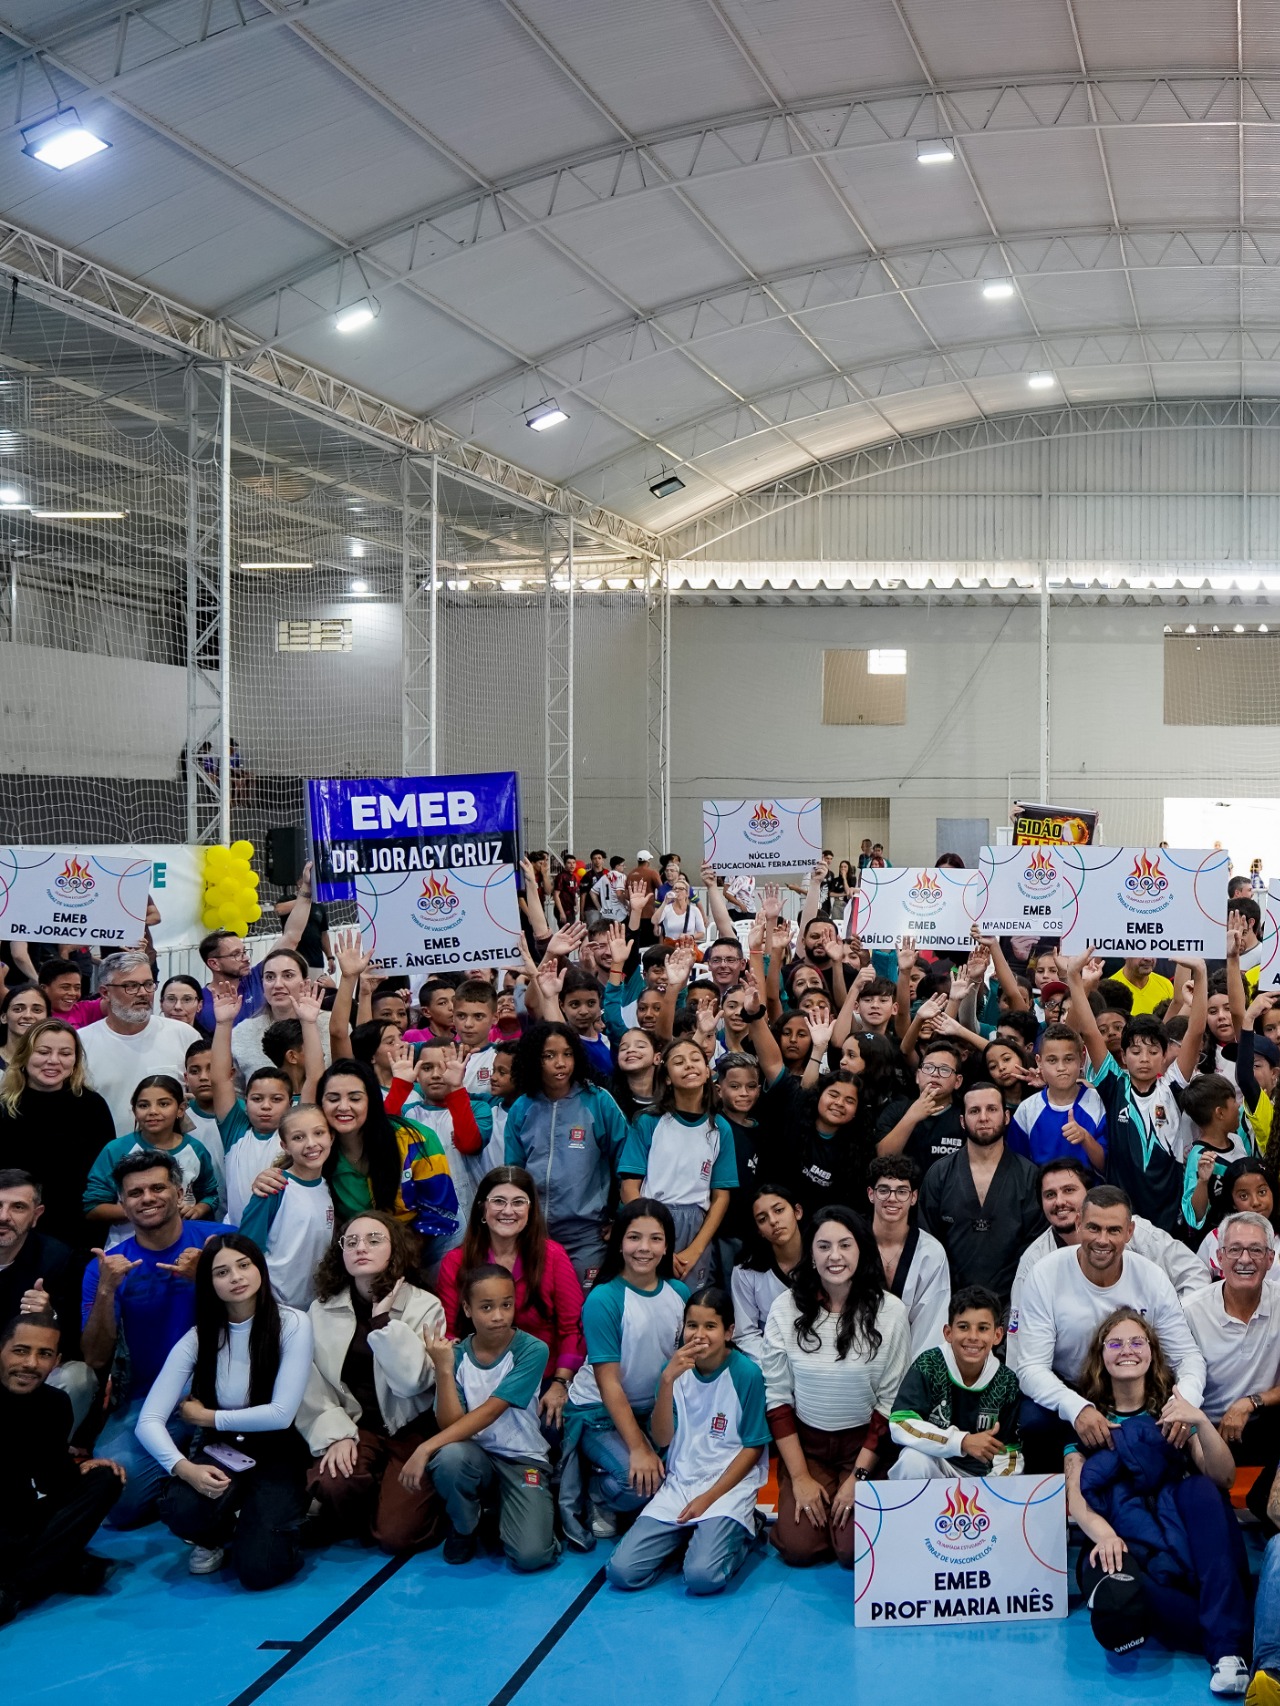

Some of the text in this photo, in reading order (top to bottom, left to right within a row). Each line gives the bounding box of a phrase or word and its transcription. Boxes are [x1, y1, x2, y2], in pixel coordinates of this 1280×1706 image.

[350, 790, 478, 831] EMEB
[1016, 817, 1063, 839] SIDÃO
[331, 841, 503, 874] DR. JORACY CRUZ
[748, 850, 781, 861] NÚCLEO
[711, 858, 817, 870] EDUCACIONAL FERRAZENSE
[1023, 905, 1052, 915] EMEB
[53, 912, 88, 924] EMEB
[10, 923, 126, 940] DR. JORACY CRUZ
[908, 921, 937, 930] EMEB
[1126, 922, 1164, 934] EMEB
[423, 936, 461, 950] EMEB
[860, 932, 894, 944] ABÍLIO
[896, 934, 955, 945] SUNDINO
[1086, 938, 1204, 951] LUCIANO POLETTI
[405, 952, 461, 967] ÂNGELO
[462, 946, 522, 962] CASTELO
[941, 1137, 962, 1147] EMEB
[810, 1164, 832, 1180] EMEB
[934, 1570, 991, 1591] EMEB
[934, 1597, 1000, 1618] MARIA
[1006, 1587, 1054, 1614] INÊS
